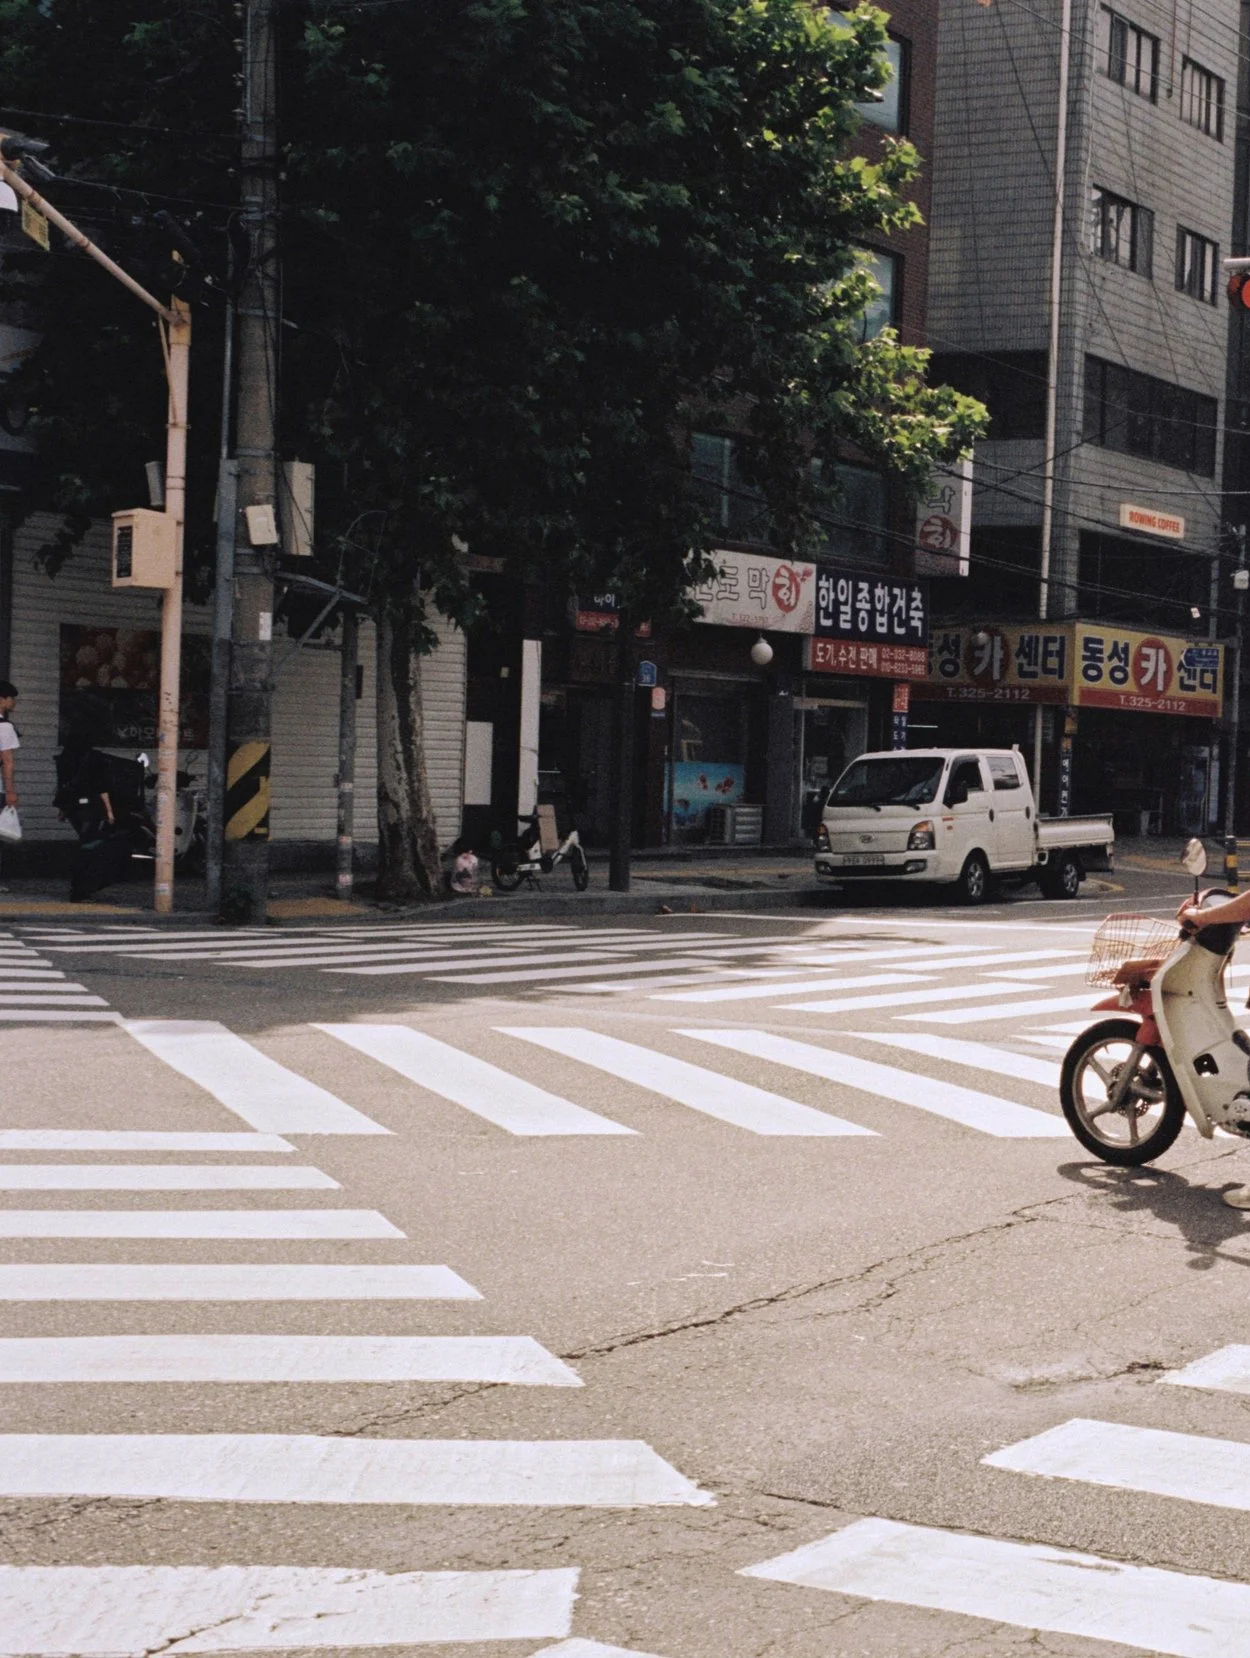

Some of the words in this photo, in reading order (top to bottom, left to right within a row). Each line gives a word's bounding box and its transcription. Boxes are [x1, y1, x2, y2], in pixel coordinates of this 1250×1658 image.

[1129, 511, 1156, 528] ROWING
[1158, 518, 1180, 533] COFFEE
[818, 573, 924, 637] 한일종합건축
[1015, 634, 1065, 680] 센터
[1081, 636, 1130, 685] 동성
[1140, 646, 1166, 692] 카
[946, 686, 1030, 700] T.325-2112
[1119, 695, 1187, 712] T.325-2112
